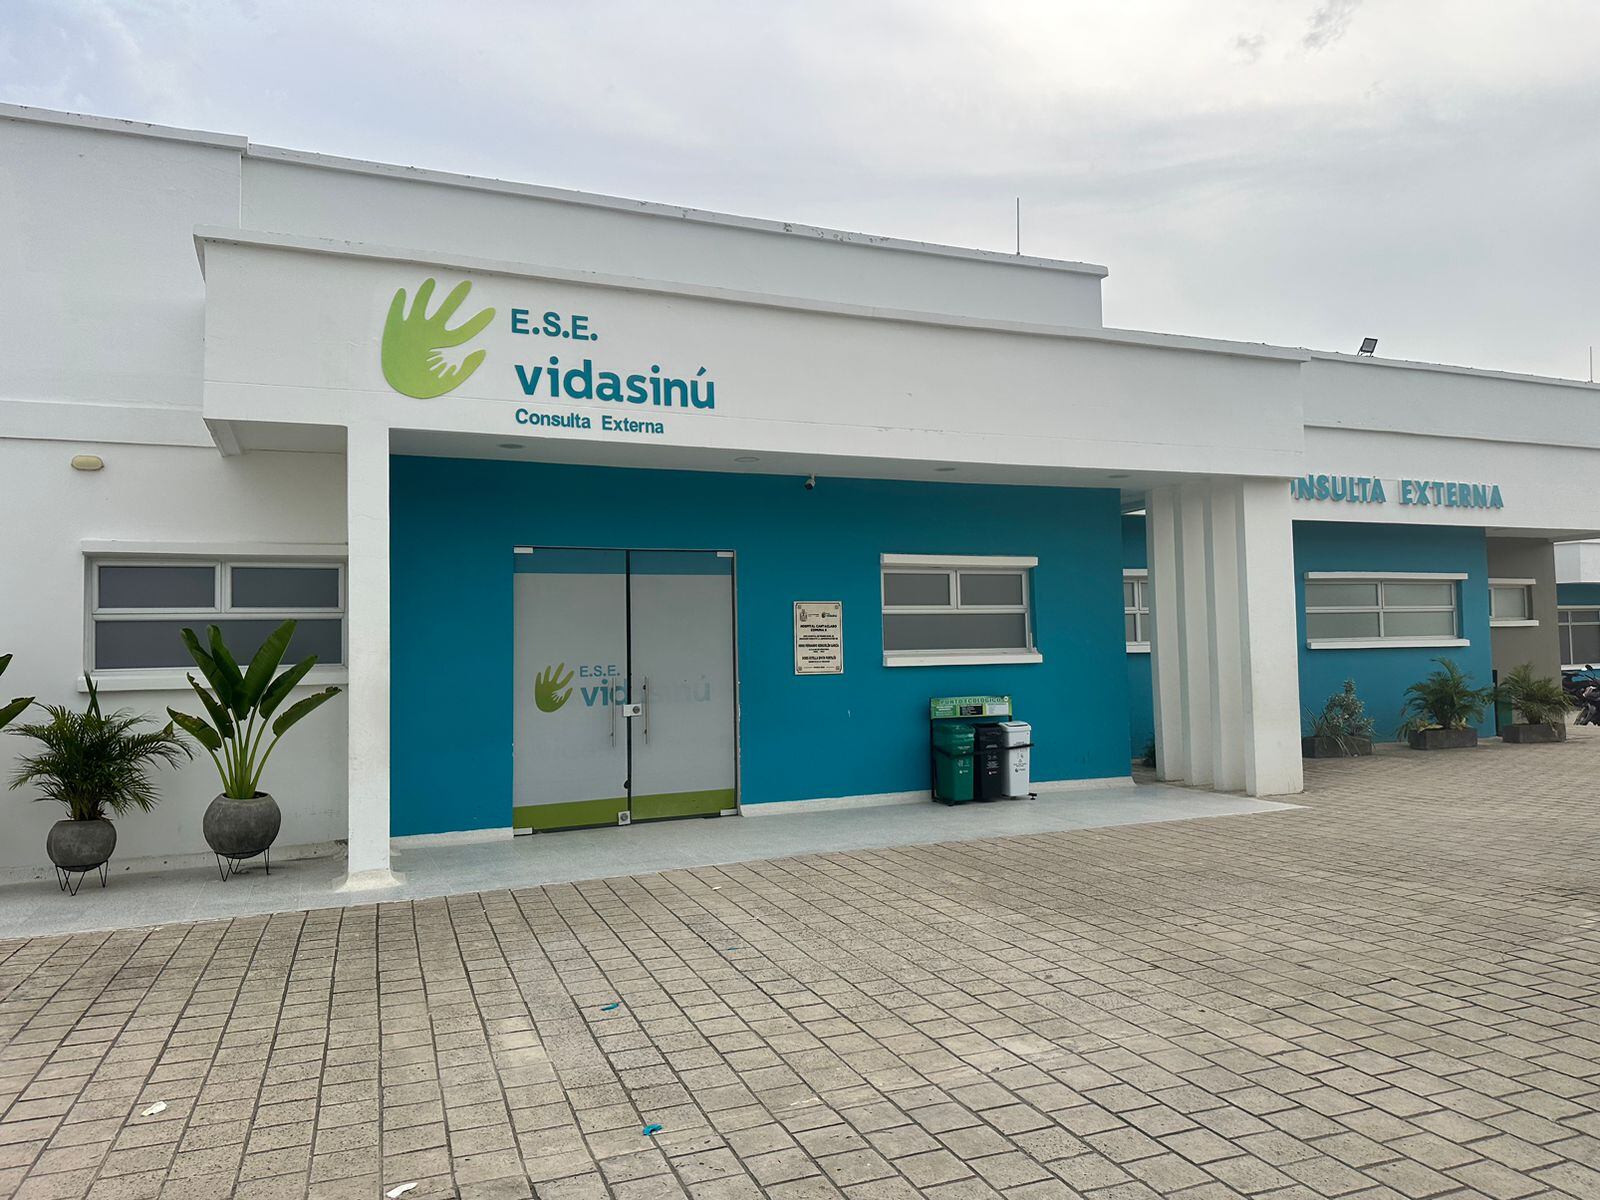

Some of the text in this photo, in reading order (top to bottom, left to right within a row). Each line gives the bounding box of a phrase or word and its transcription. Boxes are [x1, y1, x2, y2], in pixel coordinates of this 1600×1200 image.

[511, 308, 599, 341] E.S.E.
[514, 355, 715, 410] vidasinú
[515, 408, 664, 435] Consulta Externa
[1290, 474, 1504, 508] NSULTA EXTERNA
[579, 664, 621, 678] E.S.E.
